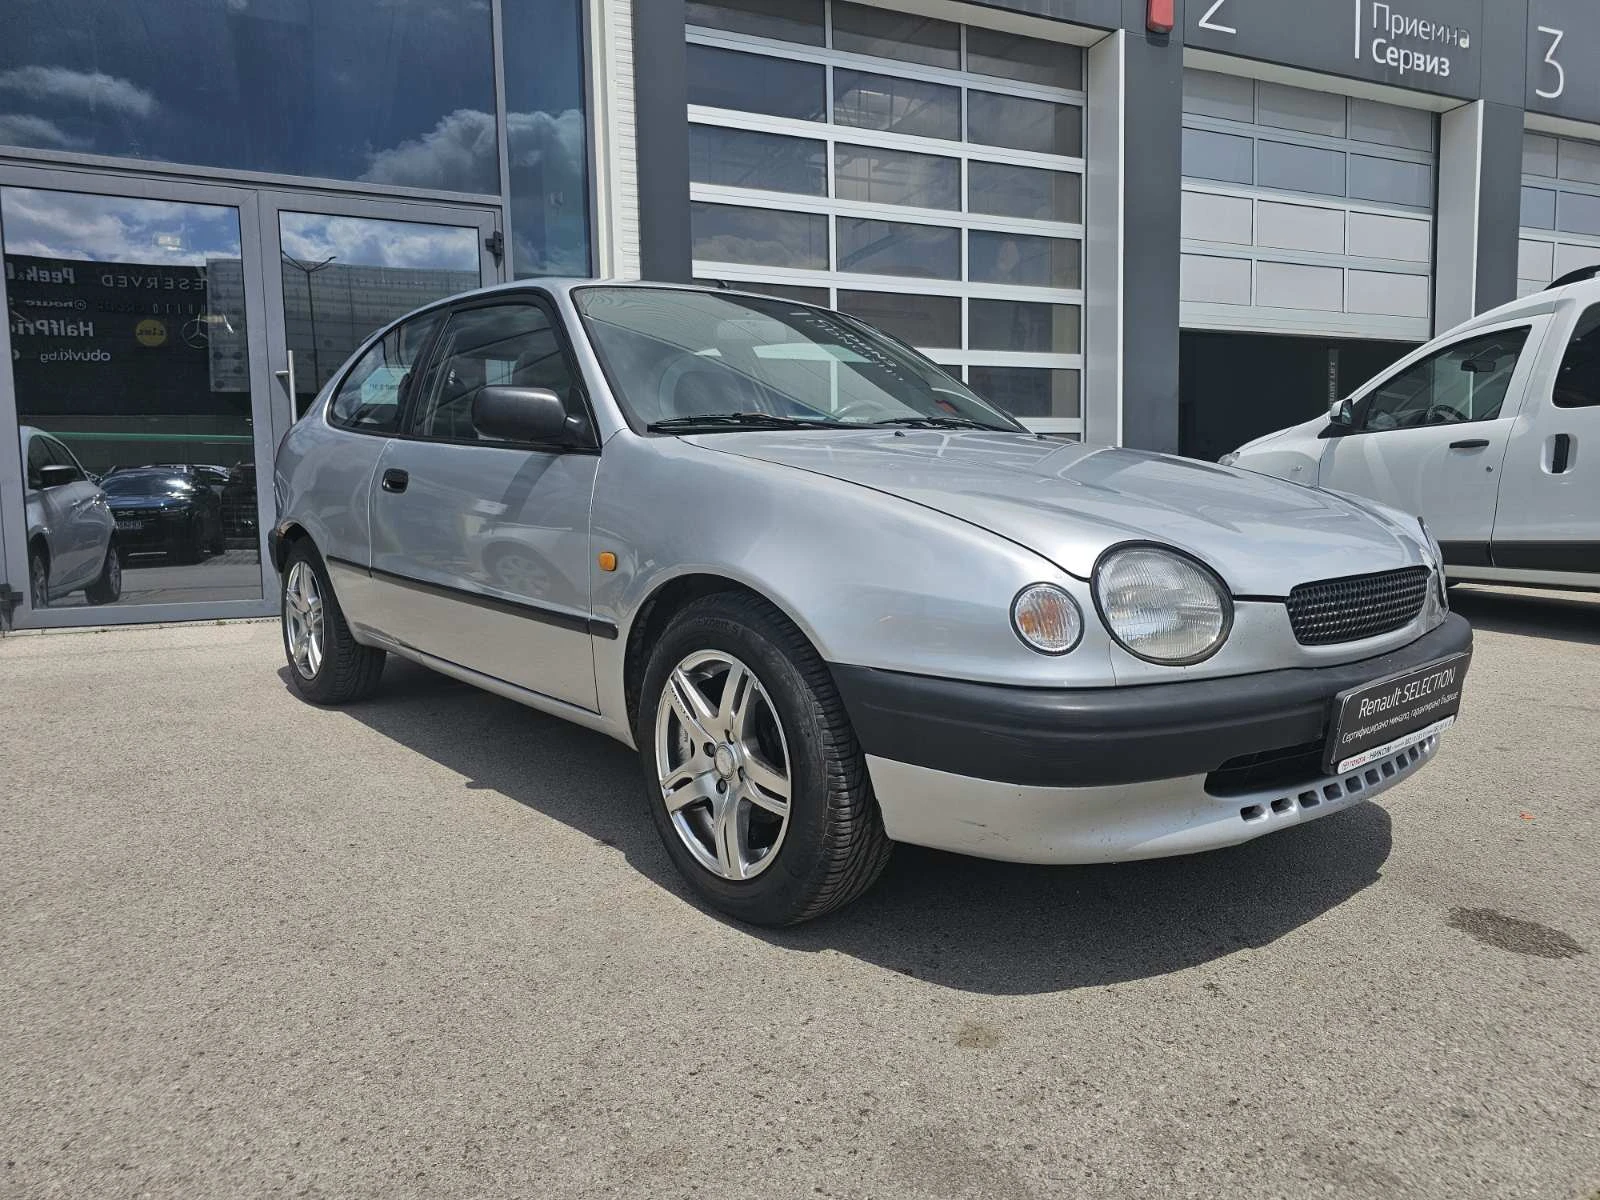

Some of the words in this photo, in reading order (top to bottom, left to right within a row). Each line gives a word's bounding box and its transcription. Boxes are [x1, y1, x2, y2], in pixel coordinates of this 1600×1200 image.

[1373, 2, 1470, 49] Приемна
[1372, 38, 1450, 77] Сервиз
[1535, 25, 1564, 98] 3
[1359, 687, 1402, 719] Renault
[1402, 667, 1456, 704] SELECTION
